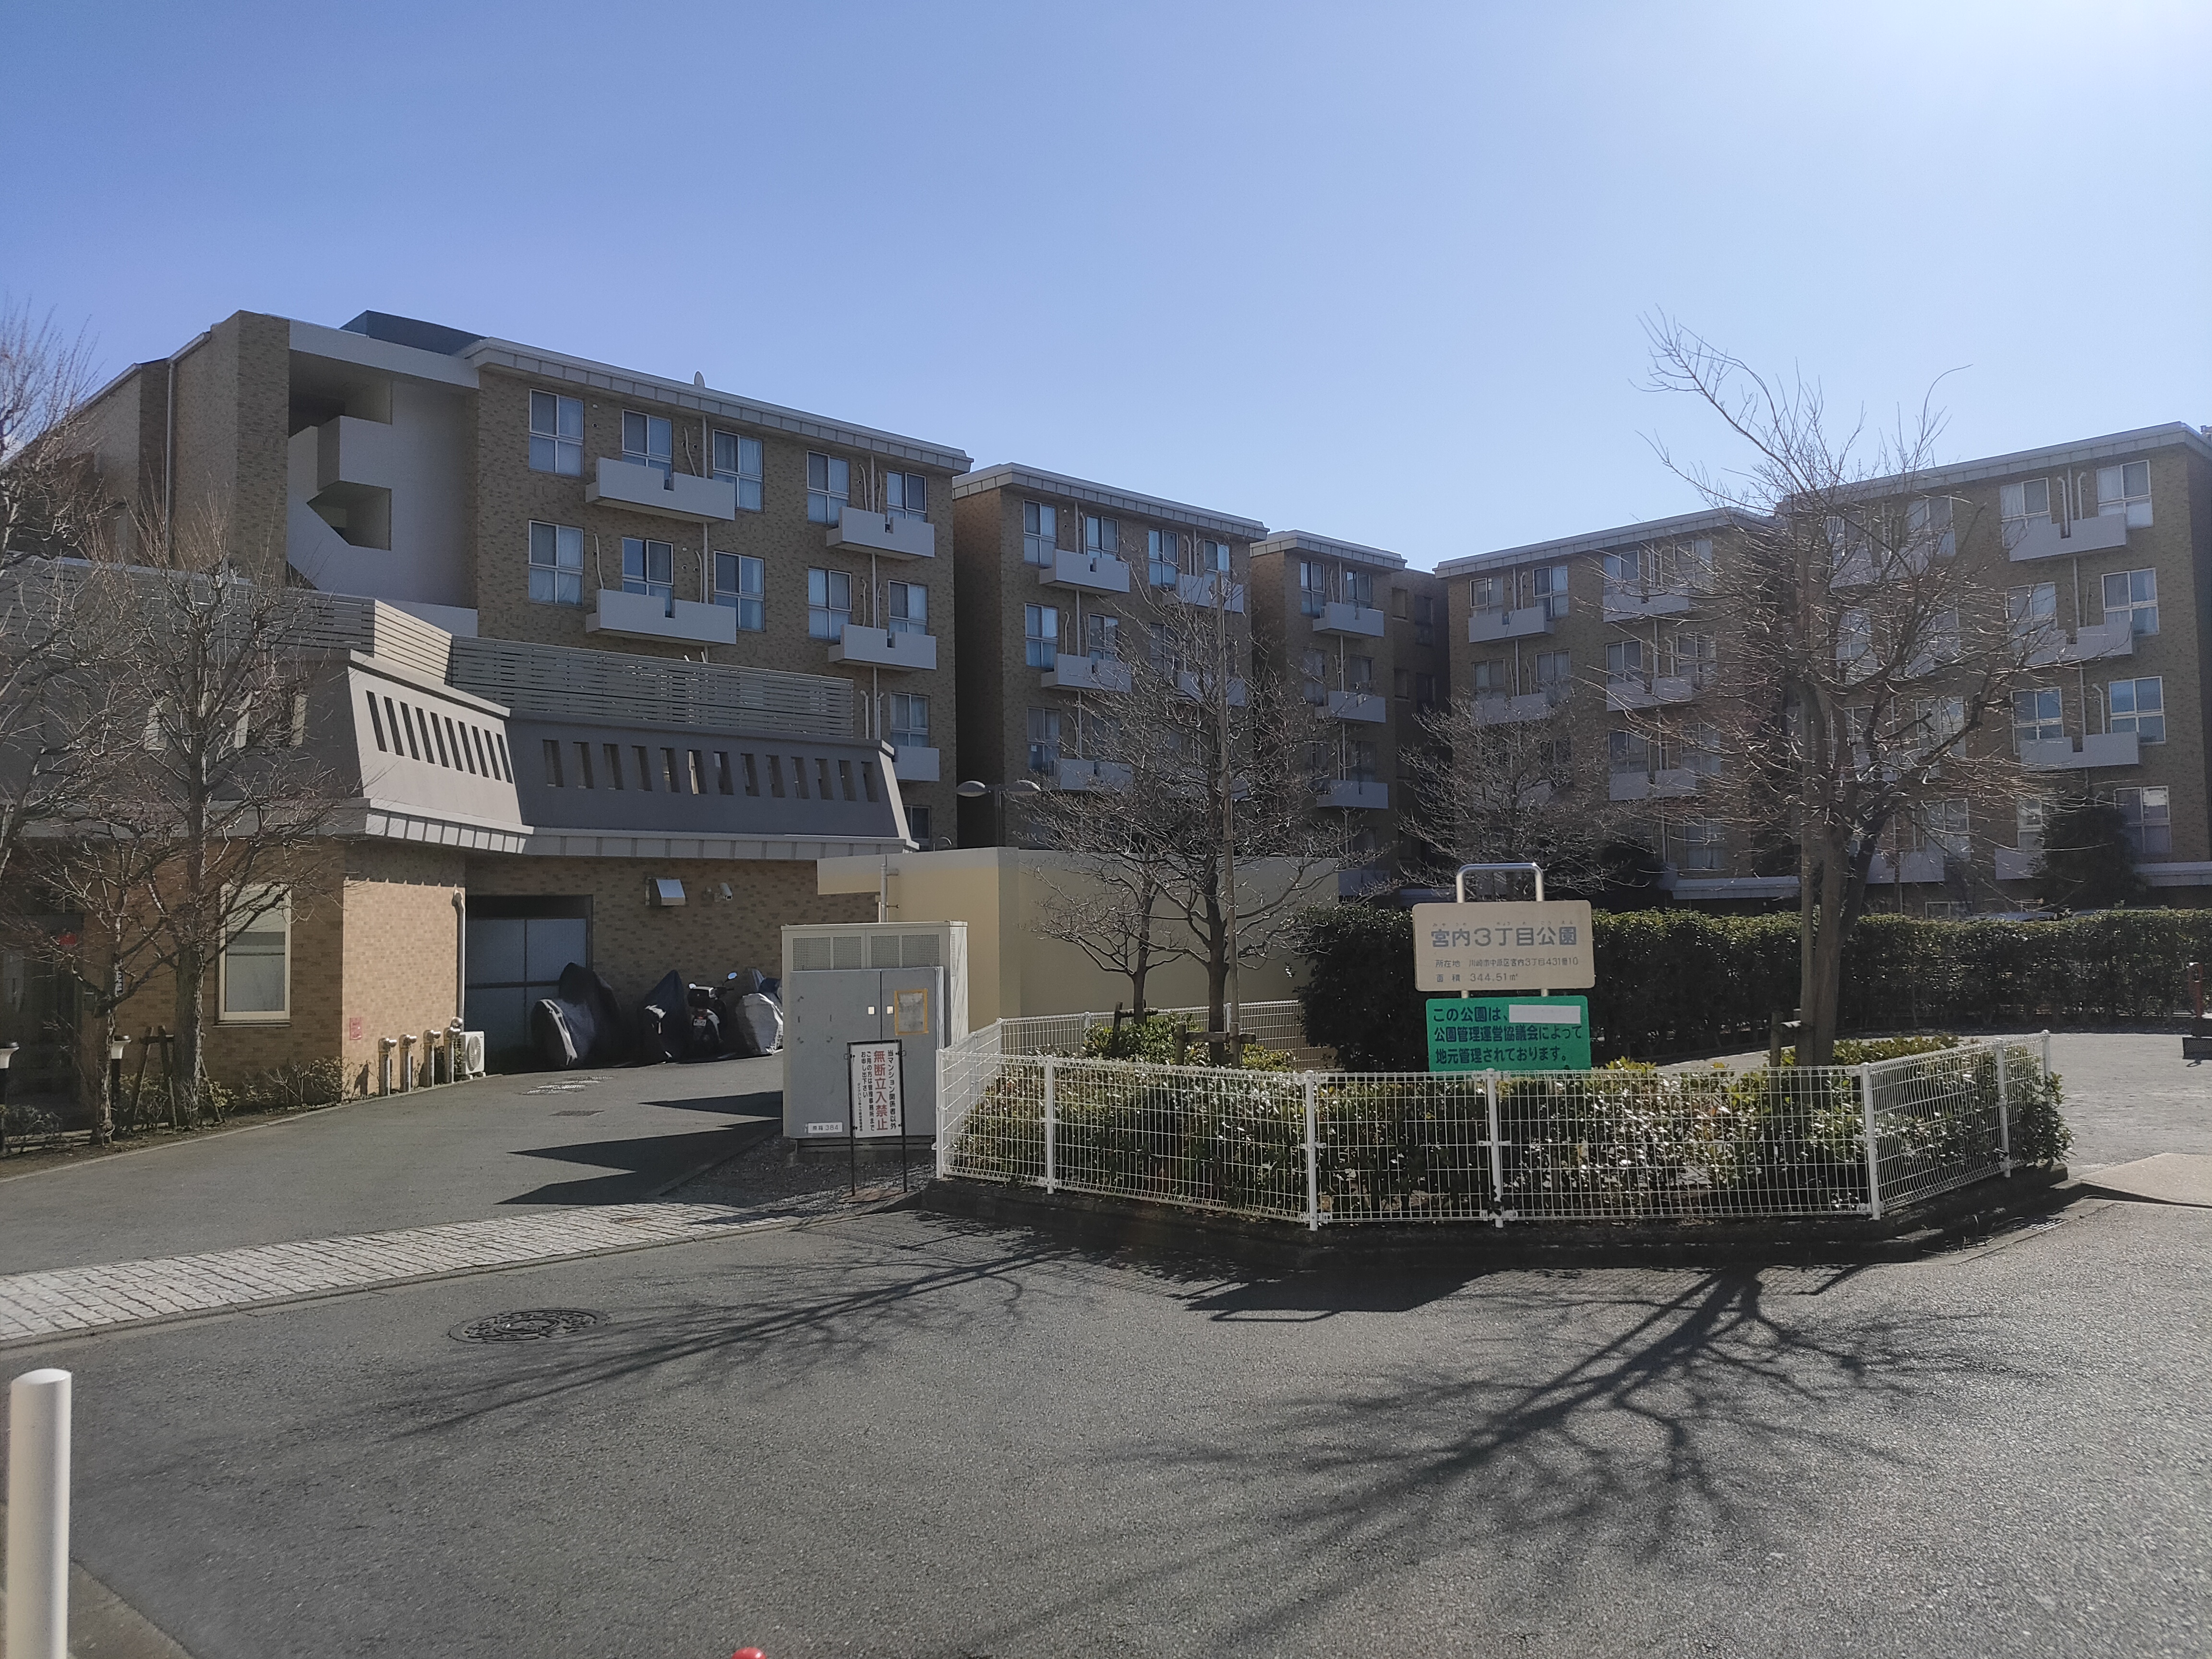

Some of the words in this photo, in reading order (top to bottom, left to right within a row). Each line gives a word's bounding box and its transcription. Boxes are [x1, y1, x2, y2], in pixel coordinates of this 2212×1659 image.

[1431, 926, 1576, 947] 宮内3丁目公園
[1435, 960, 1460, 968] 所在地
[1434, 1025, 1582, 1042] 公園管理運営協議会によって
[1435, 1046, 1566, 1064] 地元管理されております。
[874, 1050, 888, 1131] 無断立入禁止
[887, 1049, 897, 1130] 当マンション関係者以外
